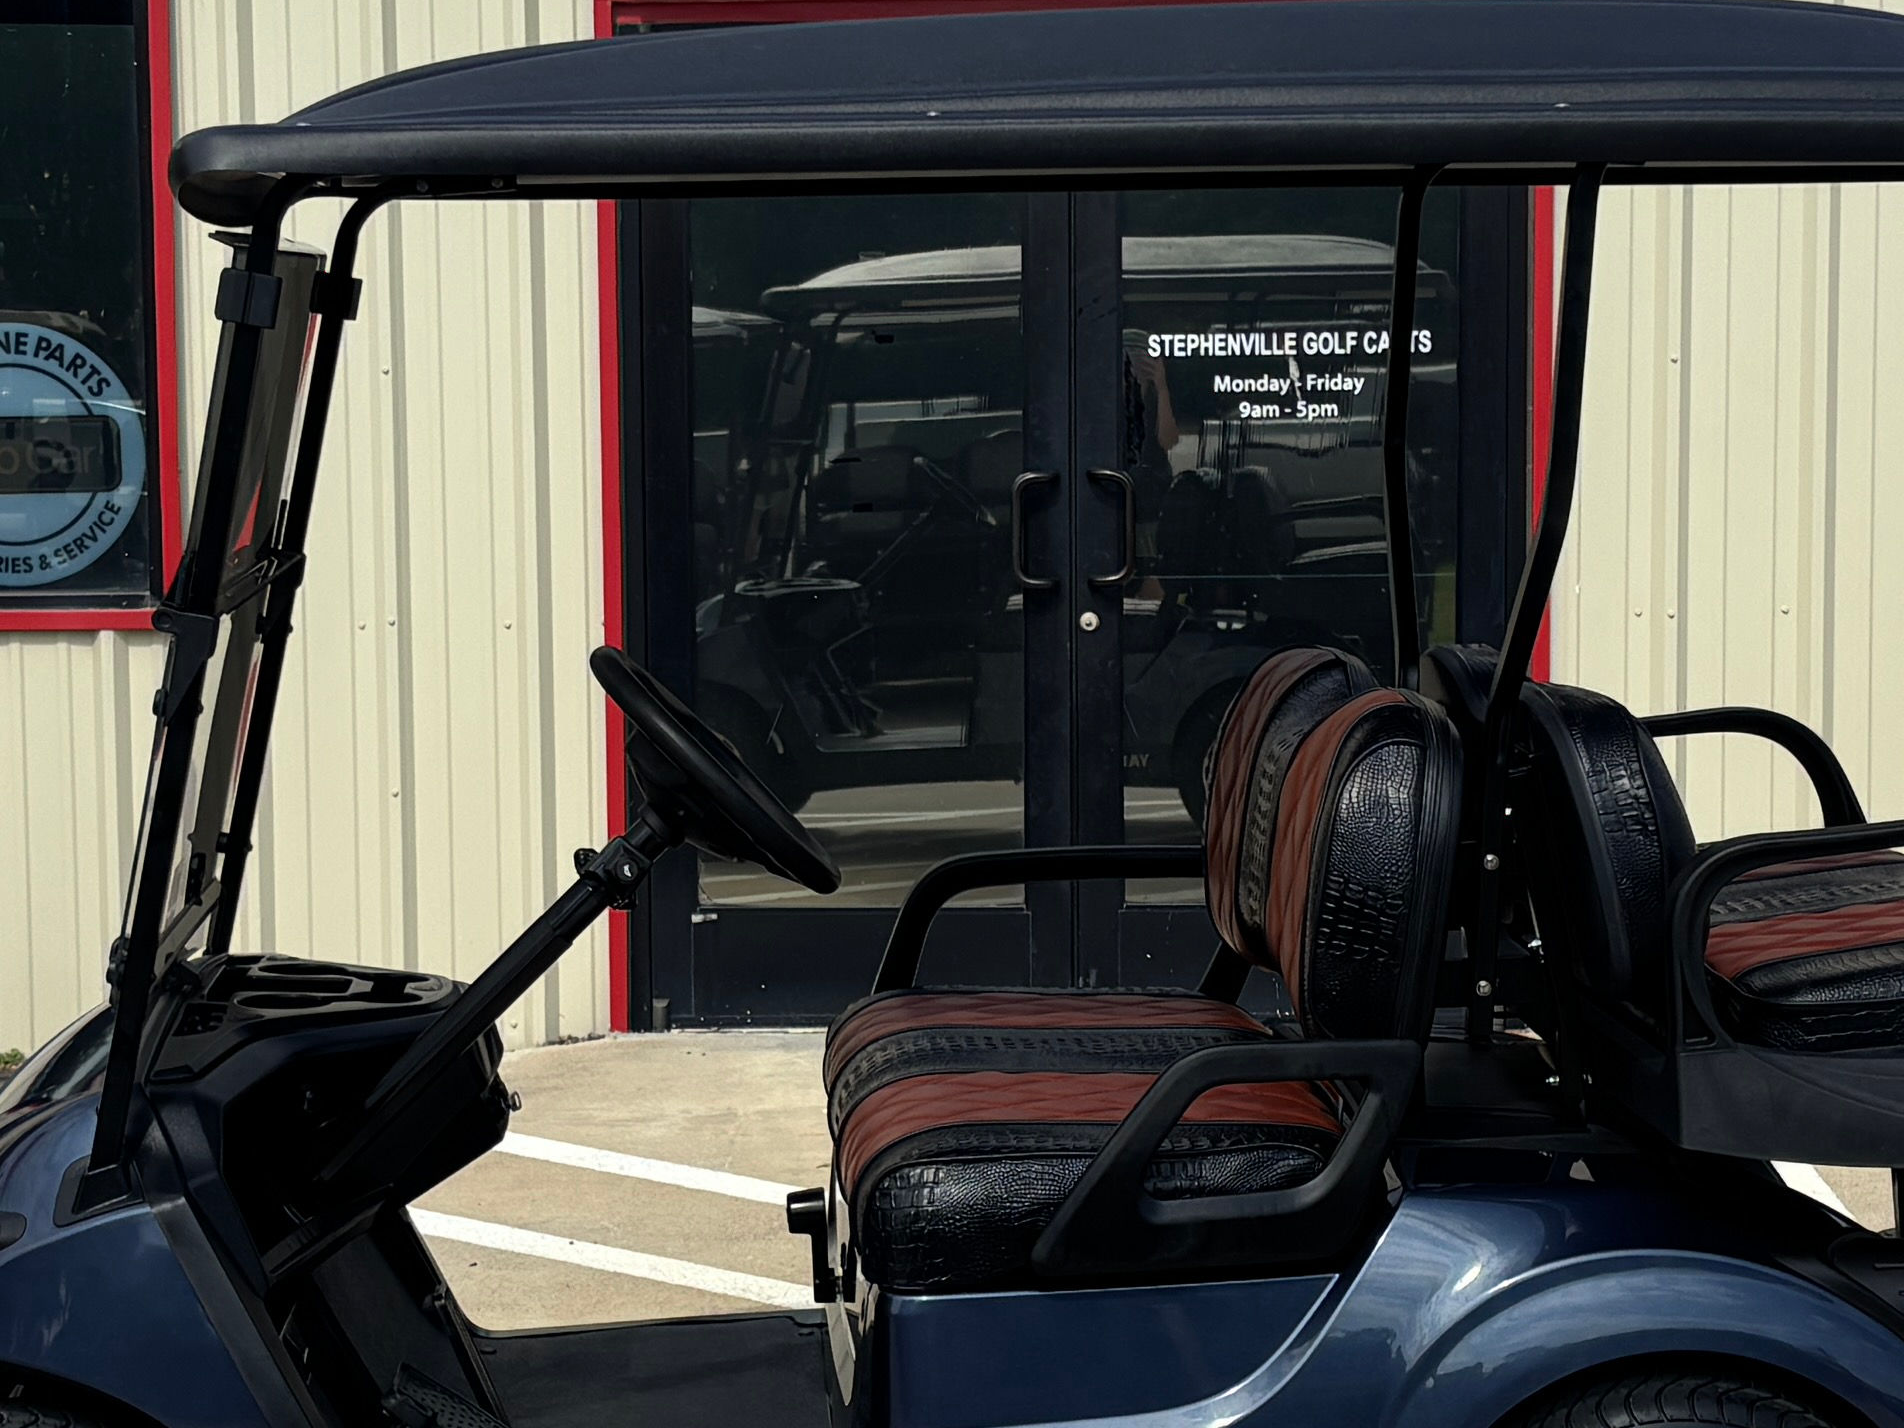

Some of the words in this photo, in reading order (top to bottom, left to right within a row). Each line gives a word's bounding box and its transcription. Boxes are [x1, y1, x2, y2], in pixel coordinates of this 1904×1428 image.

[1147, 332, 1297, 358] STEPHENVILLE
[1303, 332, 1359, 355] GOLF
[1363, 330, 1433, 354] CATS
[33, 336, 111, 397] PARTS
[1214, 375, 1291, 396] Monday
[1306, 373, 1365, 395] Friday
[1239, 402, 1280, 418] 9am
[1296, 401, 1338, 421] 5pm
[25, 439, 97, 474] Car
[39, 554, 51, 571] &
[53, 500, 121, 565] SERVICE
